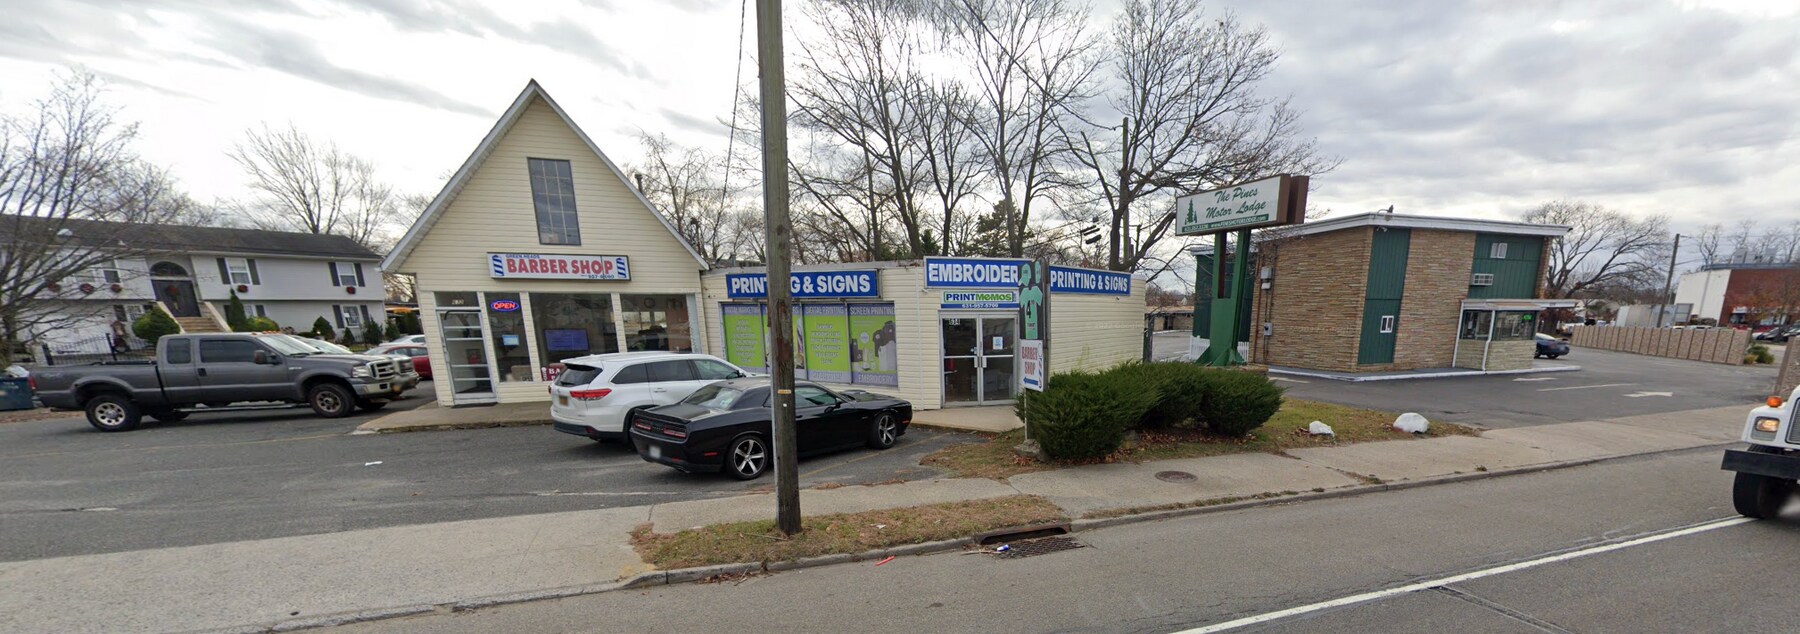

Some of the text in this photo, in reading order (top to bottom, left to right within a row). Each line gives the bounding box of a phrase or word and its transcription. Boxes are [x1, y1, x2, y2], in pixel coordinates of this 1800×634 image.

[1215, 187, 1258, 204] The Pines
[1206, 201, 1266, 219] Motor Lodge
[506, 258, 613, 274] BARBER SHOP
[928, 264, 1018, 283] EMBROIDER
[731, 274, 871, 294] PRING & SIGNS
[1050, 270, 1128, 292] PRINTING & SIGNS
[1025, 361, 1035, 375] SHOP
